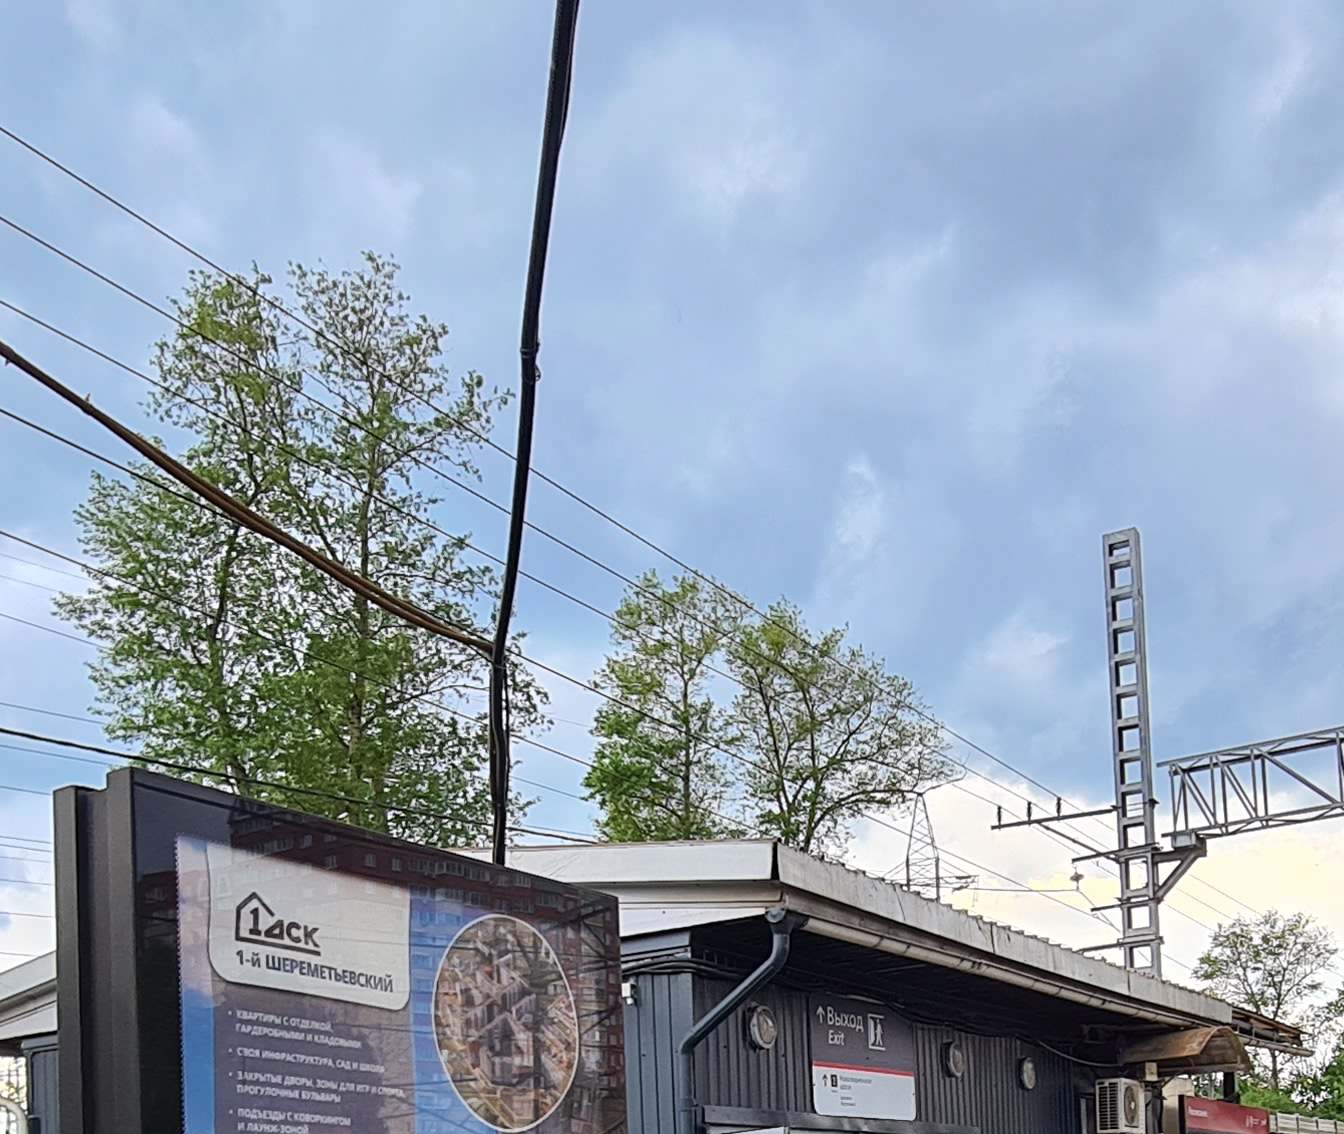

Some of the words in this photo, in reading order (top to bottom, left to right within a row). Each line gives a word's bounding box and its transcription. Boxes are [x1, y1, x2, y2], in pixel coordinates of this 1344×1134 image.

[236, 950, 261, 968] 1-й
[265, 954, 394, 993] ШЕРЕМЕТЬЕВСКИЙ
[236, 1010, 282, 1025] КВАРТИРЫ
[283, 1016, 289, 1026] С
[827, 1006, 864, 1032] Выход
[828, 1030, 845, 1046] Exit
[336, 1059, 352, 1070] САД
[237, 1070, 282, 1085] ЗАКРЫТЫЕ
[237, 1084, 300, 1099] ПРОГУЛОЧНЫЕ
[301, 1090, 341, 1103] БУЛЬВАРЫ
[237, 1108, 286, 1122] ПОДЪЕЗДЫ
[287, 1112, 292, 1121] С
[237, 1121, 245, 1131] И
